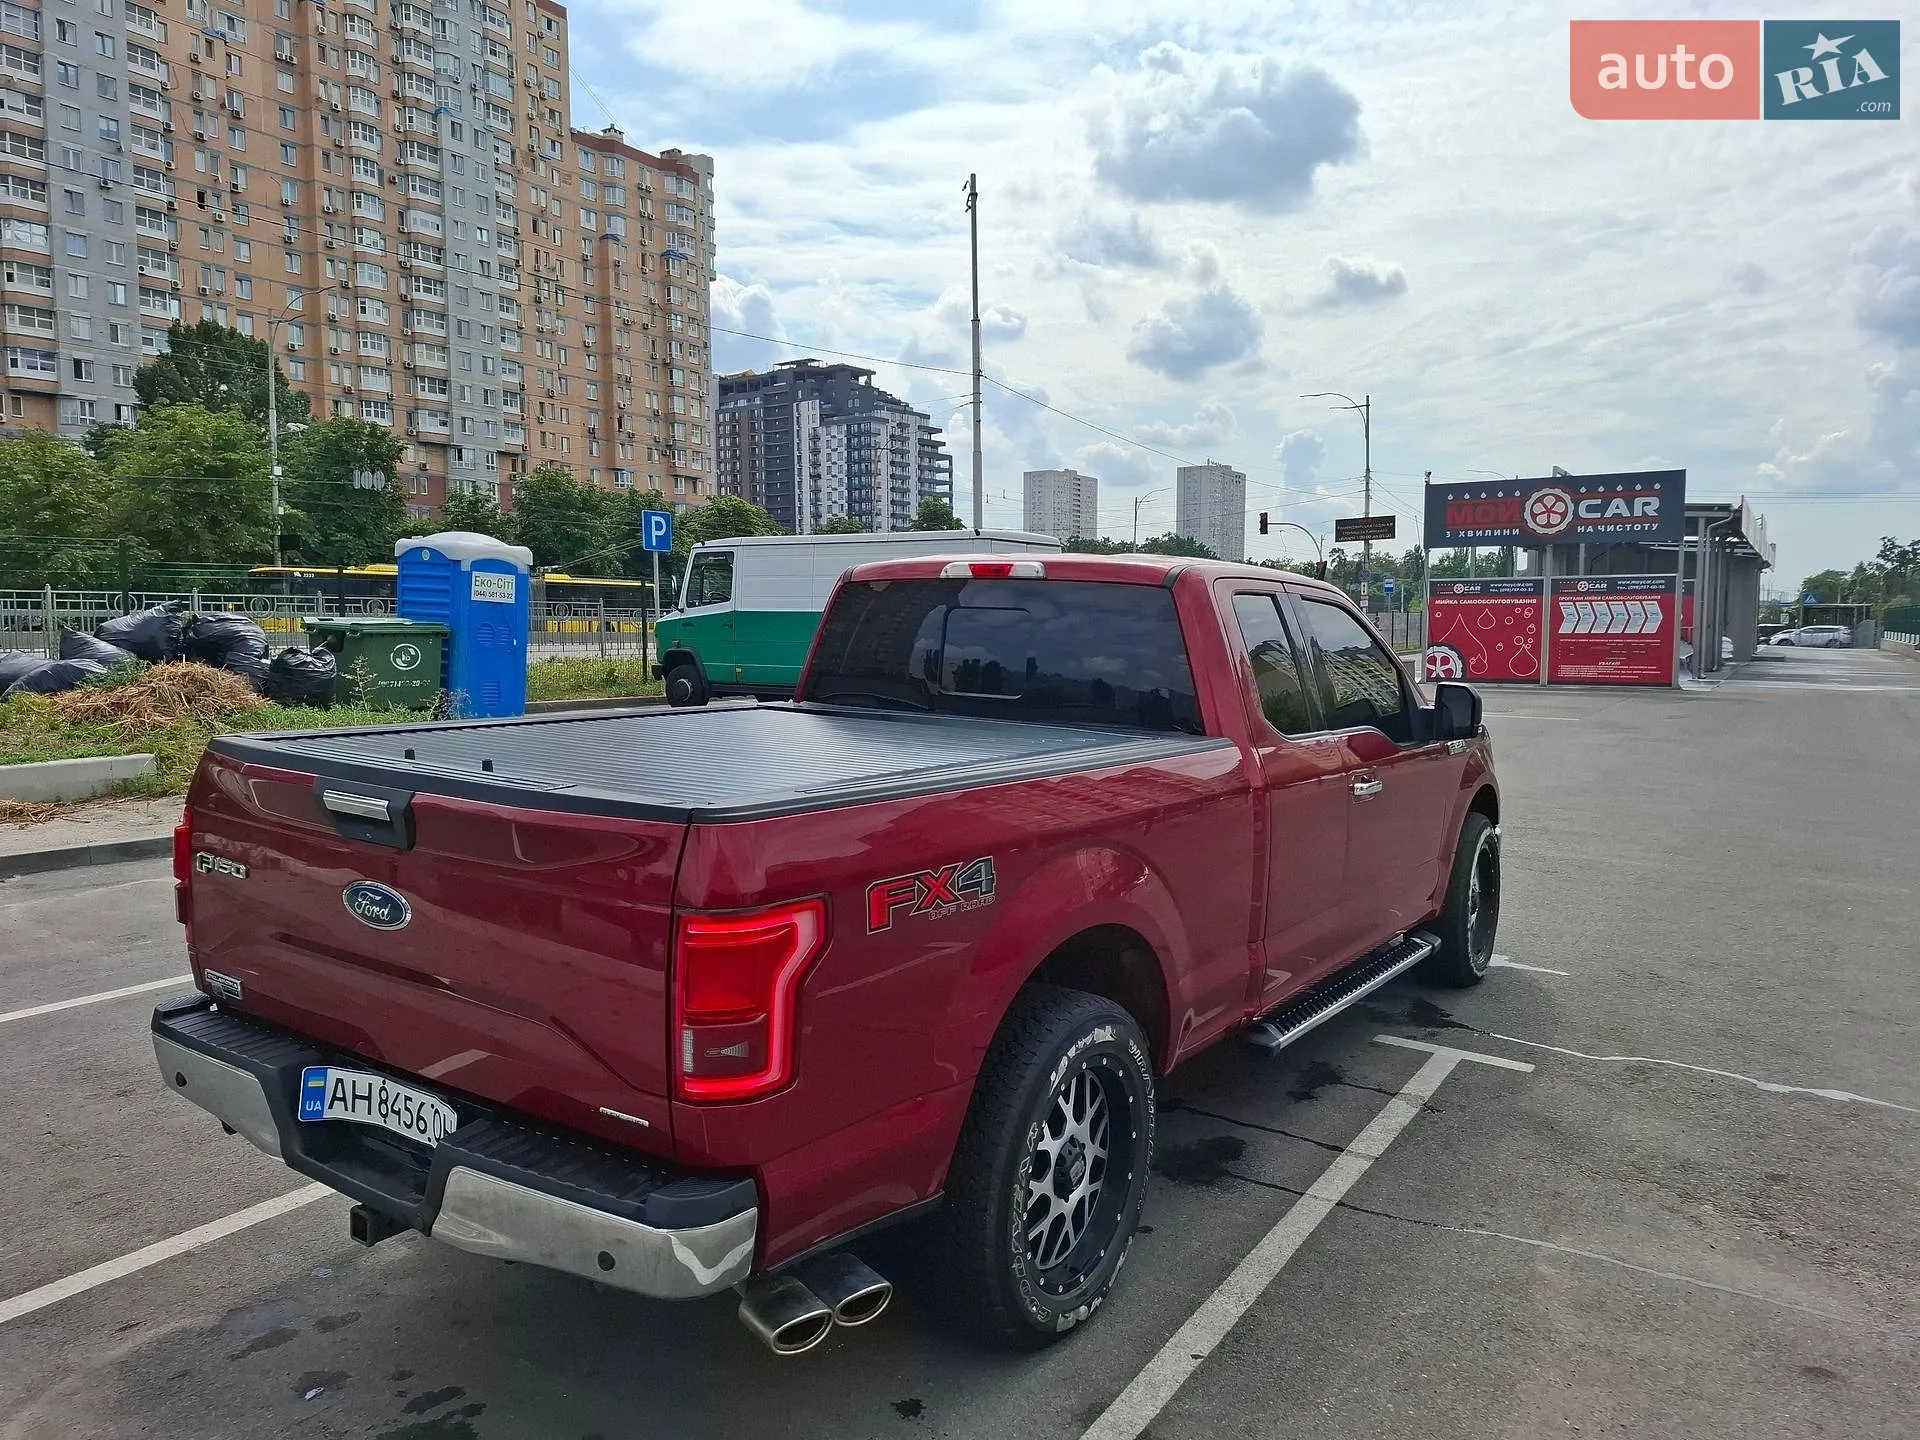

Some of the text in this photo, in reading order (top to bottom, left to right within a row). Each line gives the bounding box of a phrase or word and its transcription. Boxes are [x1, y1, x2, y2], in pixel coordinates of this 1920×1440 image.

[1578, 497, 1660, 518] CAR
[651, 515, 667, 546] P
[1459, 528, 1520, 538] ХВИЛИНИ
[1577, 525, 1594, 533] НА
[1597, 523, 1659, 532] ЧИСТОТУ
[473, 590, 513, 600] (044) 581-53-22
[474, 575, 514, 590] Еко-Сіті
[354, 890, 391, 921] Ford
[866, 856, 996, 935] FX4
[928, 895, 996, 920] OFF ROAD
[305, 1101, 322, 1111] UA
[327, 1077, 373, 1116] AH
